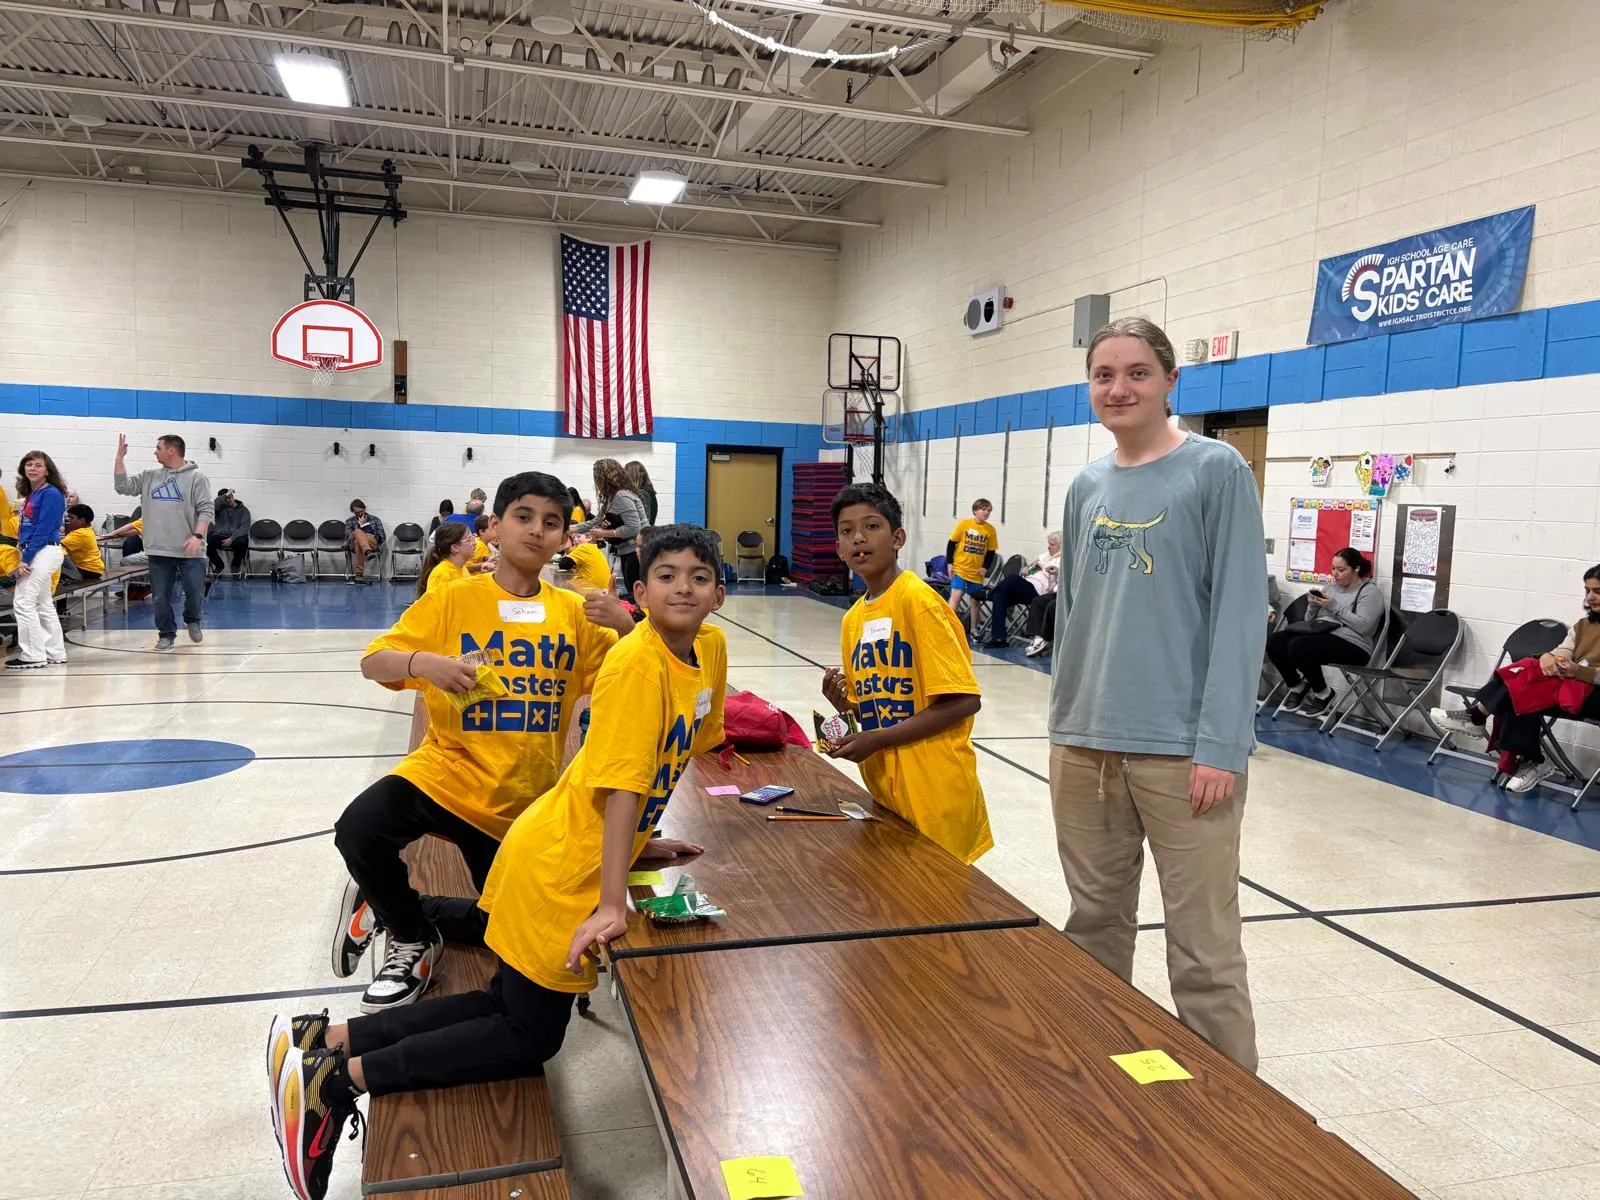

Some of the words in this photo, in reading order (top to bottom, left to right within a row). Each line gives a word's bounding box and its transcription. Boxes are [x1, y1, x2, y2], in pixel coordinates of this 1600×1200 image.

[1387, 256, 1400, 266] IGH
[1400, 249, 1432, 262] SCHOOL
[1432, 243, 1450, 255] AGE
[1451, 237, 1474, 251] CARE
[1351, 247, 1477, 322] SPARTAN
[1378, 289, 1424, 317] KIDS'
[1425, 279, 1473, 308] CARE
[1212, 335, 1229, 357] EXIT
[855, 673, 914, 698] asters
